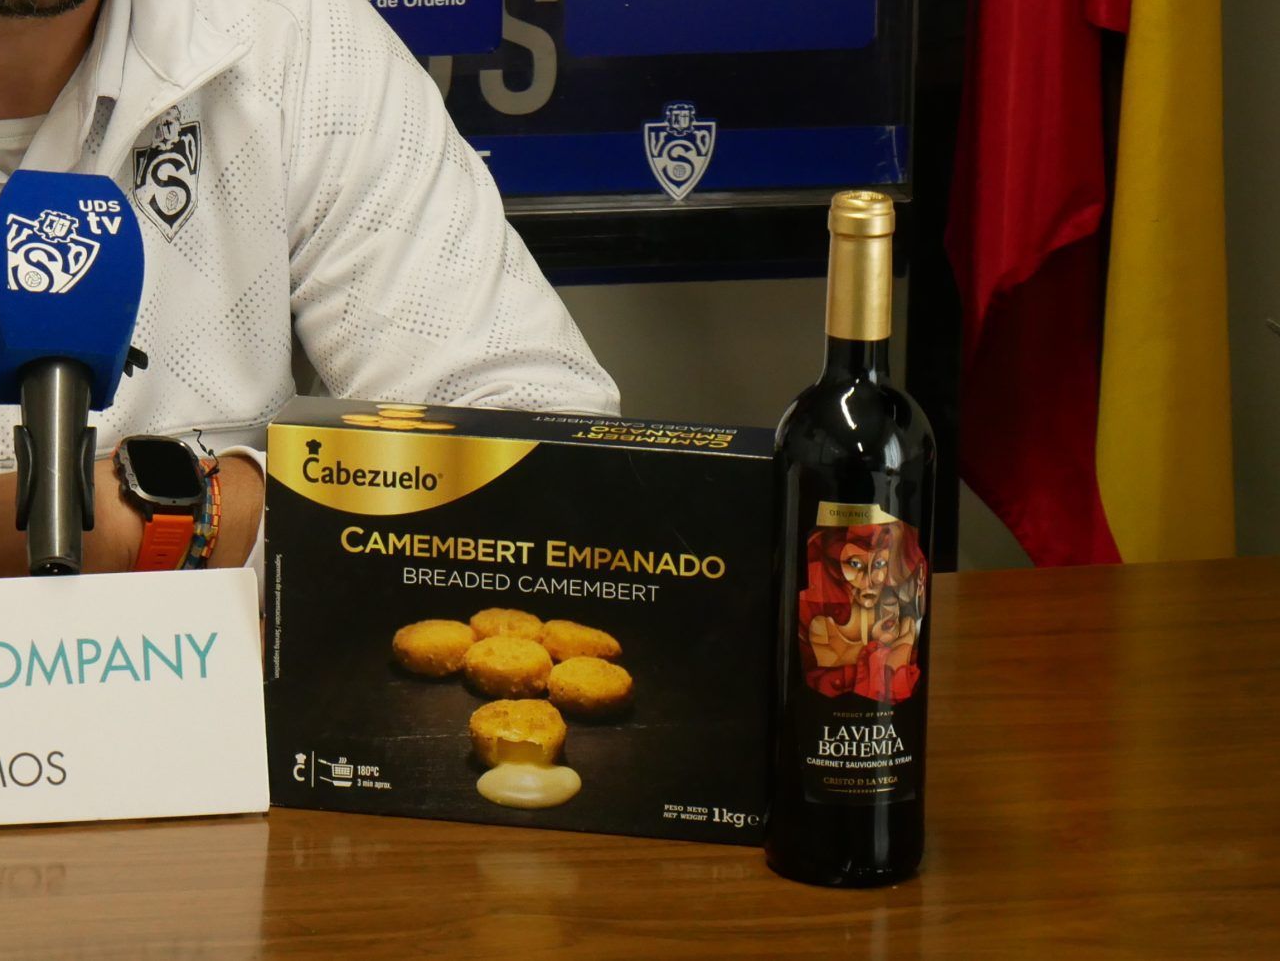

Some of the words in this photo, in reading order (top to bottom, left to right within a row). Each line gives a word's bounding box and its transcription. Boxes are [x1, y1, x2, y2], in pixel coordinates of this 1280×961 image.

[86, 212, 122, 235] tv
[340, 526, 535, 565] CAMEMBERT
[546, 540, 726, 580] EMPANADO
[402, 567, 511, 592] BREADED
[517, 575, 660, 602] CAMEMBERT
[818, 737, 905, 757] BOHEMIA
[806, 756, 844, 768] CABERNET
[845, 759, 888, 769] SAUVIGNON
[362, 779, 374, 788] min
